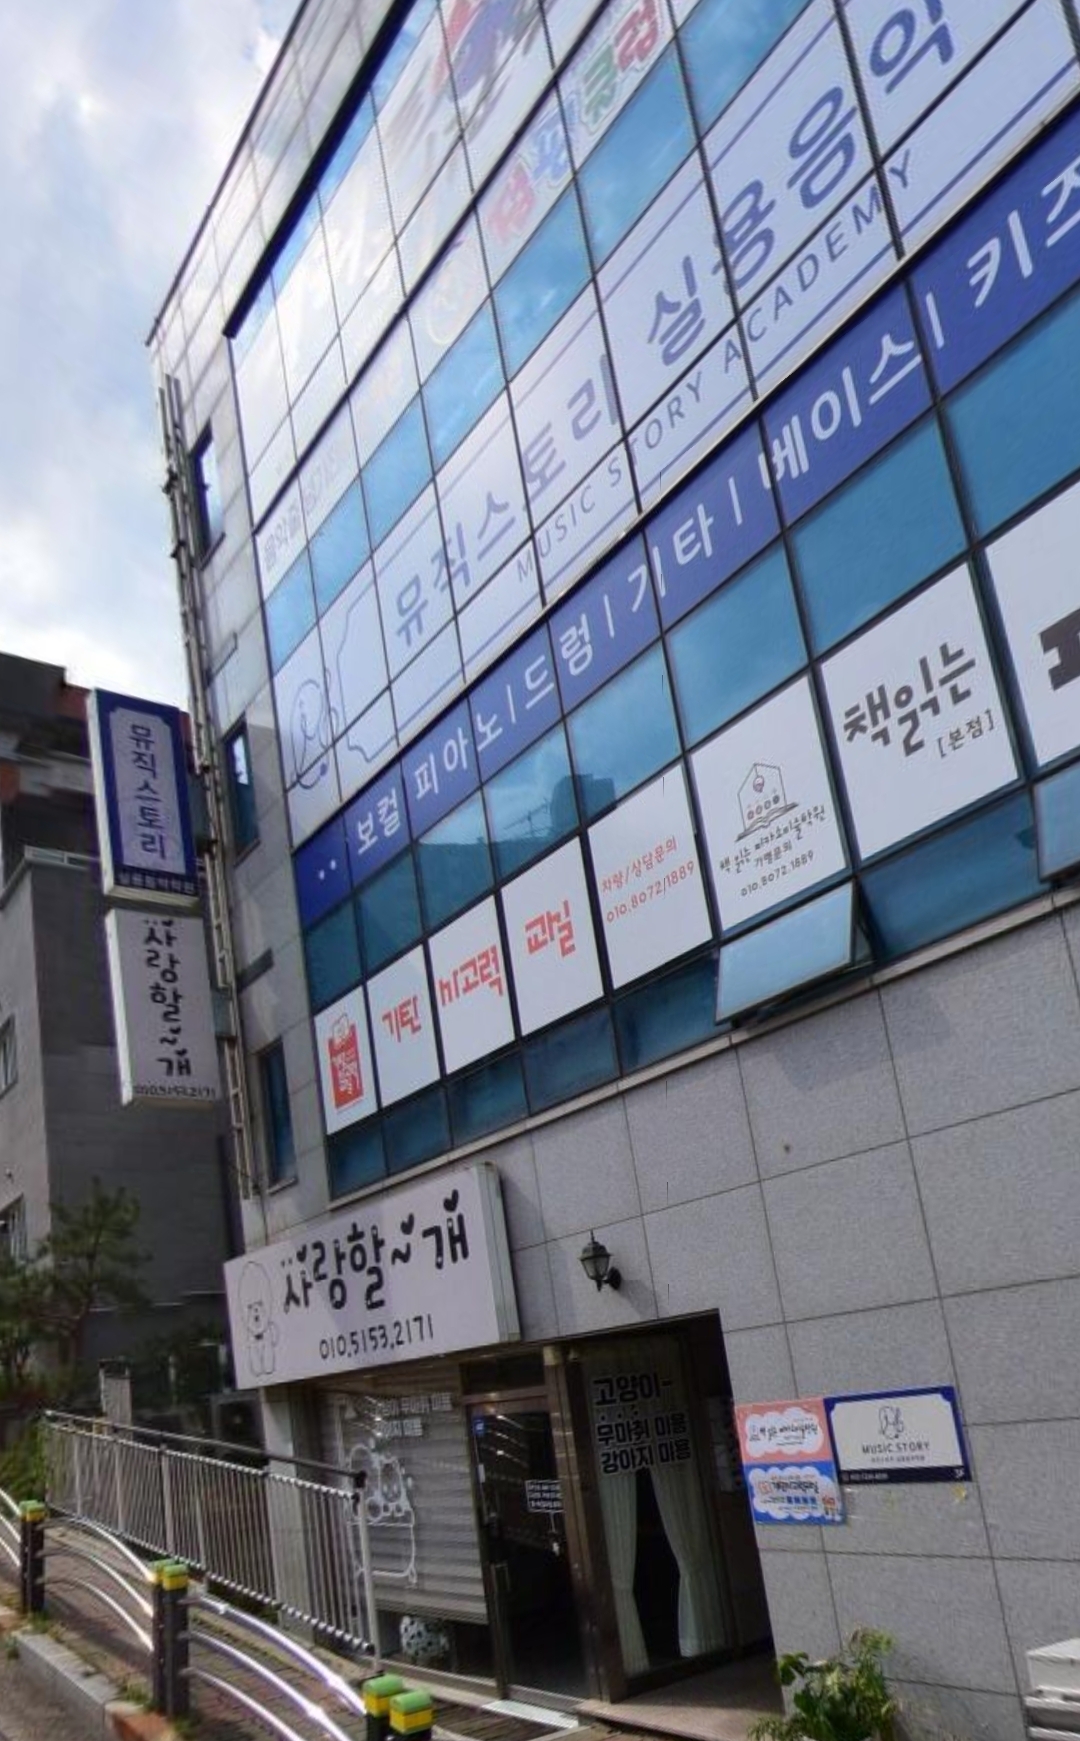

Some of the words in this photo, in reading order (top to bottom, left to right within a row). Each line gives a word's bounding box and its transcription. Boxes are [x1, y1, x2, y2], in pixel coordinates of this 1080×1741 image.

[396, 352, 619, 648] 뮤직스토리
[647, 0, 954, 368] 실용음악
[515, 484, 597, 584] MUSIC
[606, 370, 703, 488] STORY
[722, 149, 912, 375] ACADEMY
[356, 787, 402, 855] 보컬
[414, 711, 503, 801] 피아노
[522, 612, 594, 709] 드럼
[627, 503, 715, 613] 기타
[757, 332, 922, 491] 베이스
[966, 152, 1080, 308] 키즈
[843, 642, 976, 757] 책읽는
[130, 723, 168, 860] 뮤직스토리
[606, 860, 694, 924] 010.80721889
[382, 994, 422, 1043] 기탄
[319, 1313, 434, 1360] 010.5153.2171
[601, 1445, 654, 1474] 강아지
[862, 1443, 895, 1455] MUSIC
[897, 1441, 931, 1453] STORY
